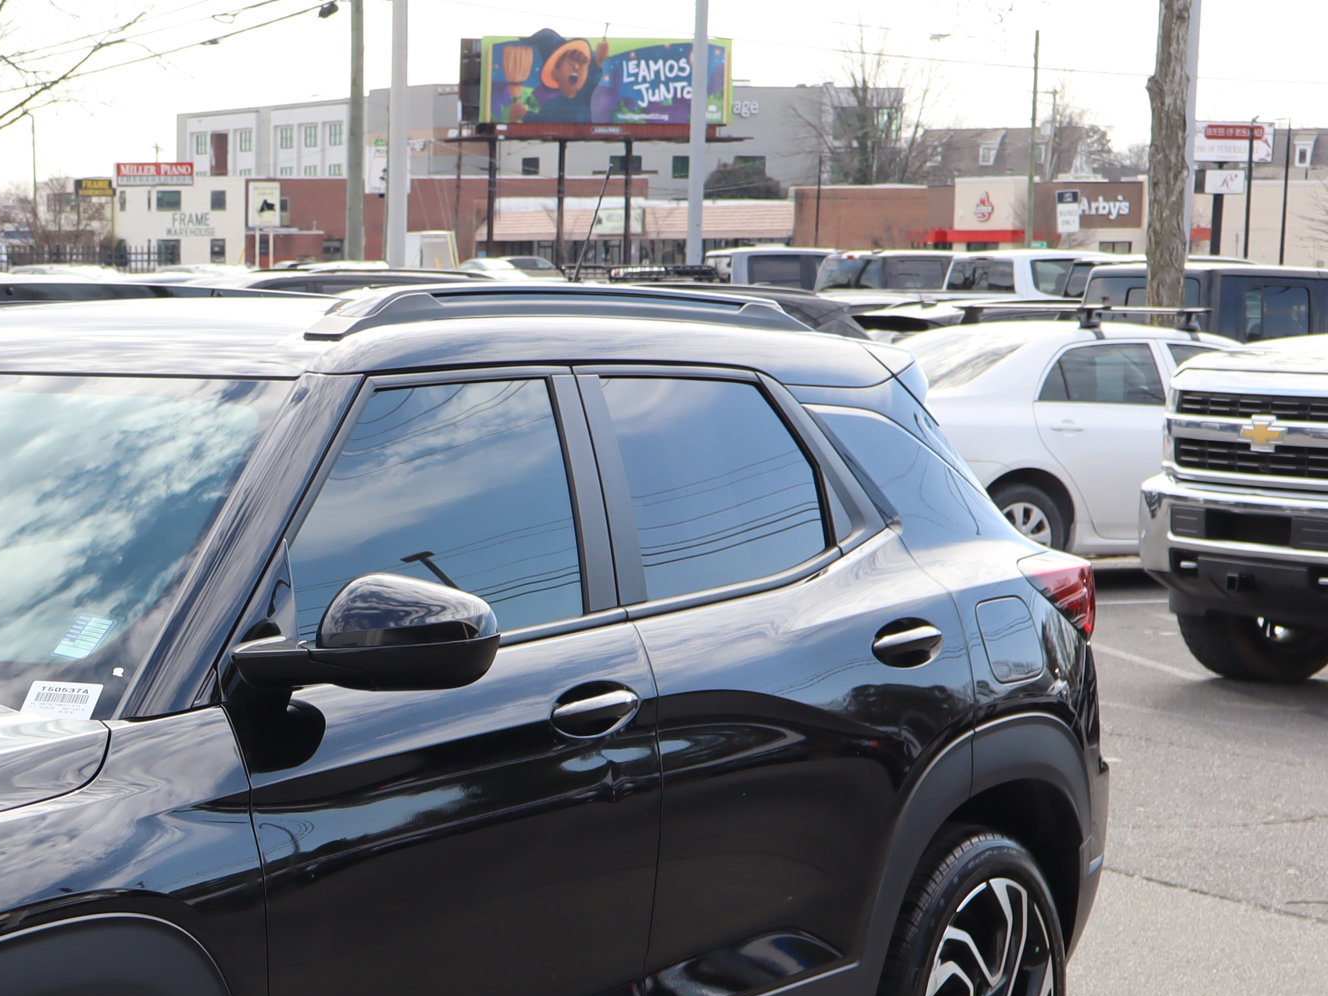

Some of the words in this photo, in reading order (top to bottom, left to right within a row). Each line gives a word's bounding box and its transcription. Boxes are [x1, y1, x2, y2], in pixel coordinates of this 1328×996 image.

[622, 58, 690, 83] LEAMOS
[633, 81, 693, 108] JUNTO
[120, 164, 156, 176] MILLER
[160, 164, 192, 176] PIANO
[1079, 194, 1130, 220] Arby's
[172, 212, 210, 227] FRAME
[166, 227, 216, 237] WAREHOUSE
[41, 686, 89, 694] T50537A
